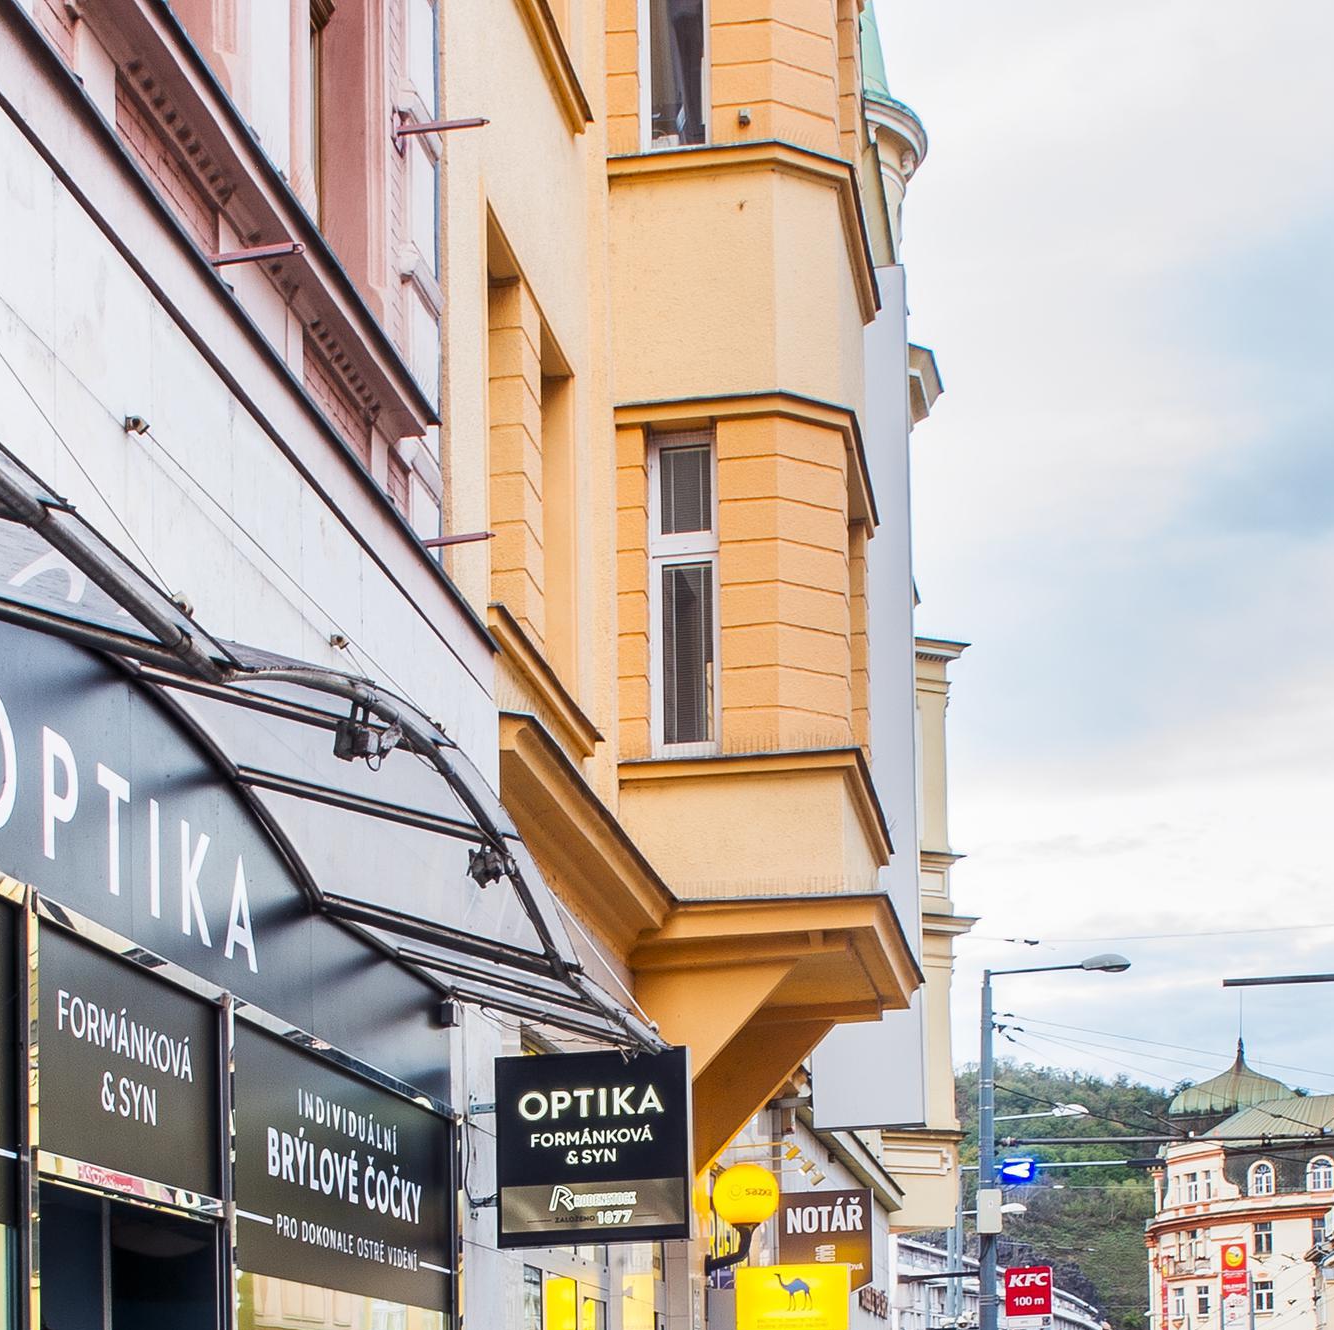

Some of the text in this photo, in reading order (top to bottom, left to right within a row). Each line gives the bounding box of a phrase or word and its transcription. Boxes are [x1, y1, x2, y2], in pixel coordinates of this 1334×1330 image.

[58, 989, 193, 1083] FORMÁNKOVÁ
[101, 1071, 157, 1126] & SYN
[518, 1084, 665, 1121] OPTIKA
[298, 1088, 397, 1155] INDIVIDUÁLNÍ
[530, 1124, 653, 1148] FORMÁNKOVÁ
[267, 1126, 422, 1224] BRÝLOVÉ ČOČKY
[566, 1148, 617, 1165] & SYN
[574, 1191, 637, 1207] RODENSTOCK
[597, 1209, 633, 1224] 1877
[786, 1197, 864, 1235] NOTÁŘ
[276, 1213, 298, 1239] PRO
[301, 1221, 354, 1255] DOKONALE
[356, 1238, 385, 1263] OSTRÉ
[1008, 1272, 1049, 1288] KFC
[1013, 1296, 1045, 1307] 100 m
